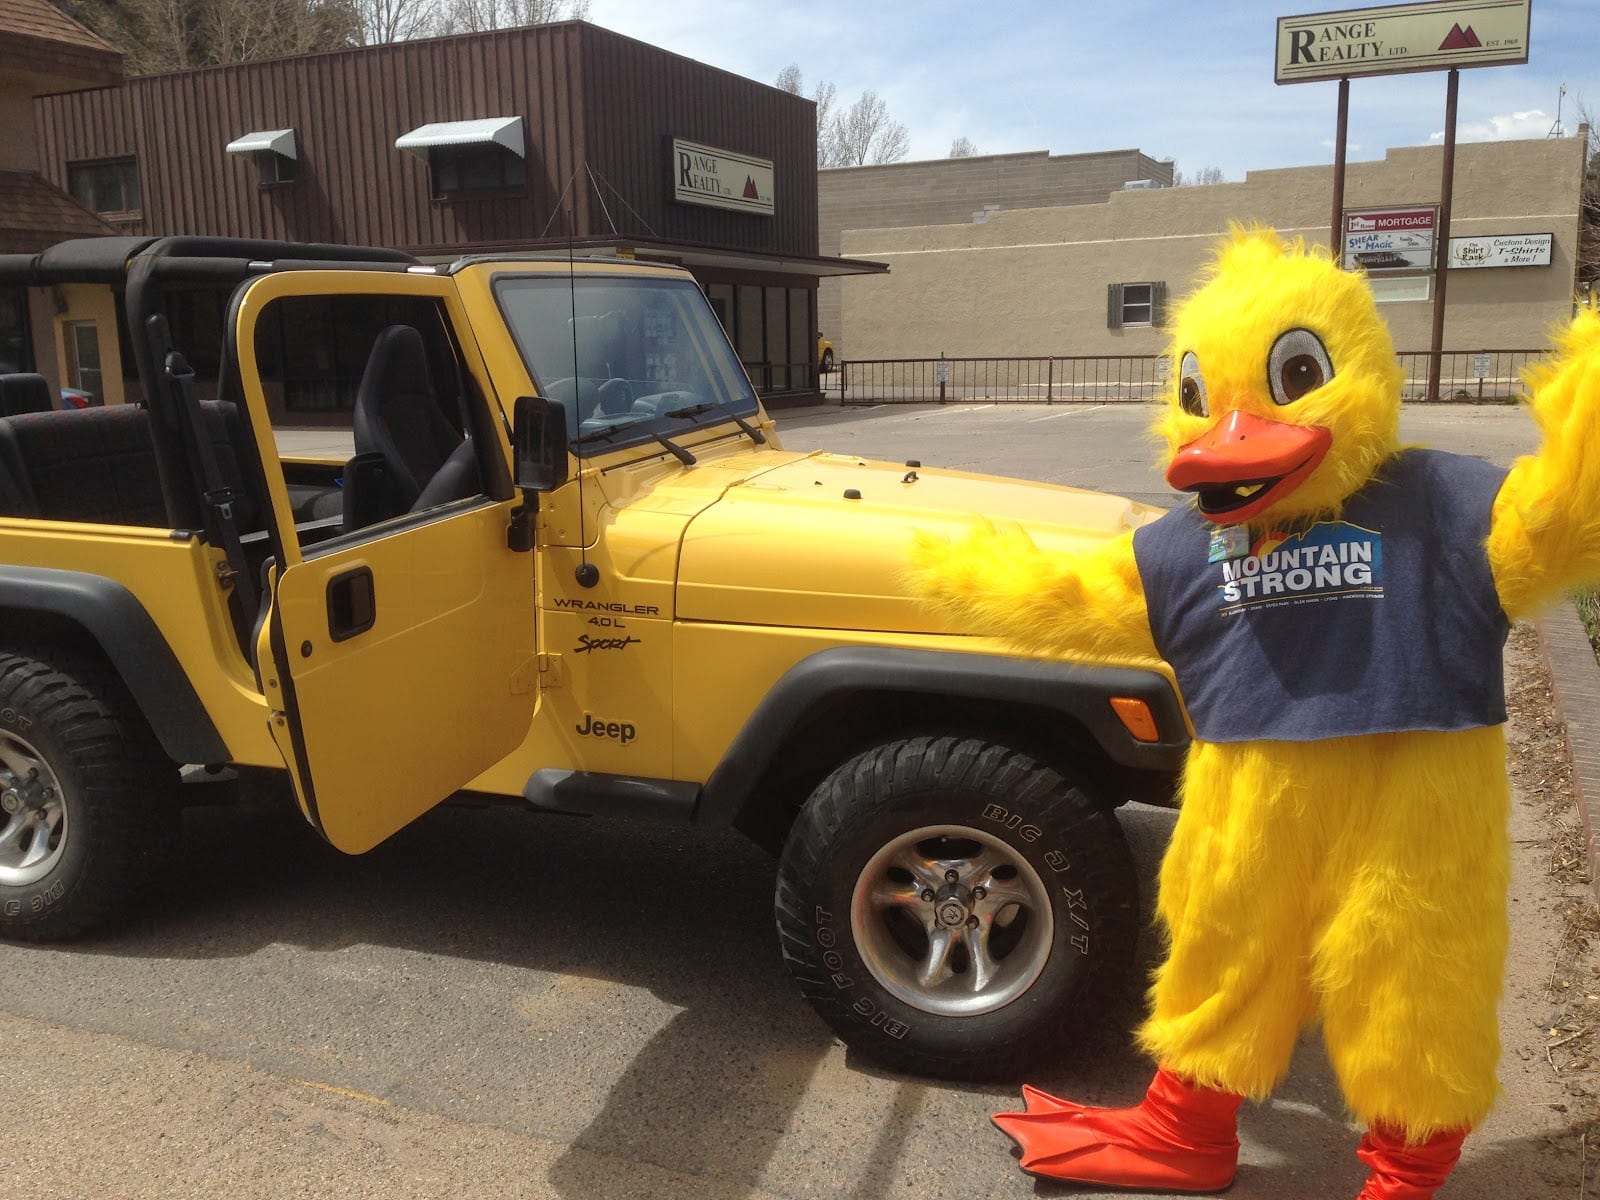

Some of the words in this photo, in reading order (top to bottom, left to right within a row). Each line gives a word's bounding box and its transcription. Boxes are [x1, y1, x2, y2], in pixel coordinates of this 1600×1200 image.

[1287, 22, 1376, 65] RANGE
[679, 151, 718, 188] RANGE
[1378, 216, 1432, 227] MORTGAGE
[1349, 234, 1379, 248] SHEAR
[1463, 247, 1485, 255] Shirt
[1494, 239, 1523, 247] Custom
[1525, 237, 1550, 247] Design
[1499, 247, 1546, 255] T-Shirts
[1222, 541, 1372, 582] MOUNTAIN
[1223, 562, 1372, 602] STRONG
[554, 598, 660, 615] WRANGLER
[574, 634, 641, 654] Sport
[575, 714, 636, 743] Jeep
[981, 803, 1043, 842] BIG
[1063, 886, 1089, 955] X/T
[816, 905, 855, 990] FOOT
[853, 997, 911, 1040] BIG
